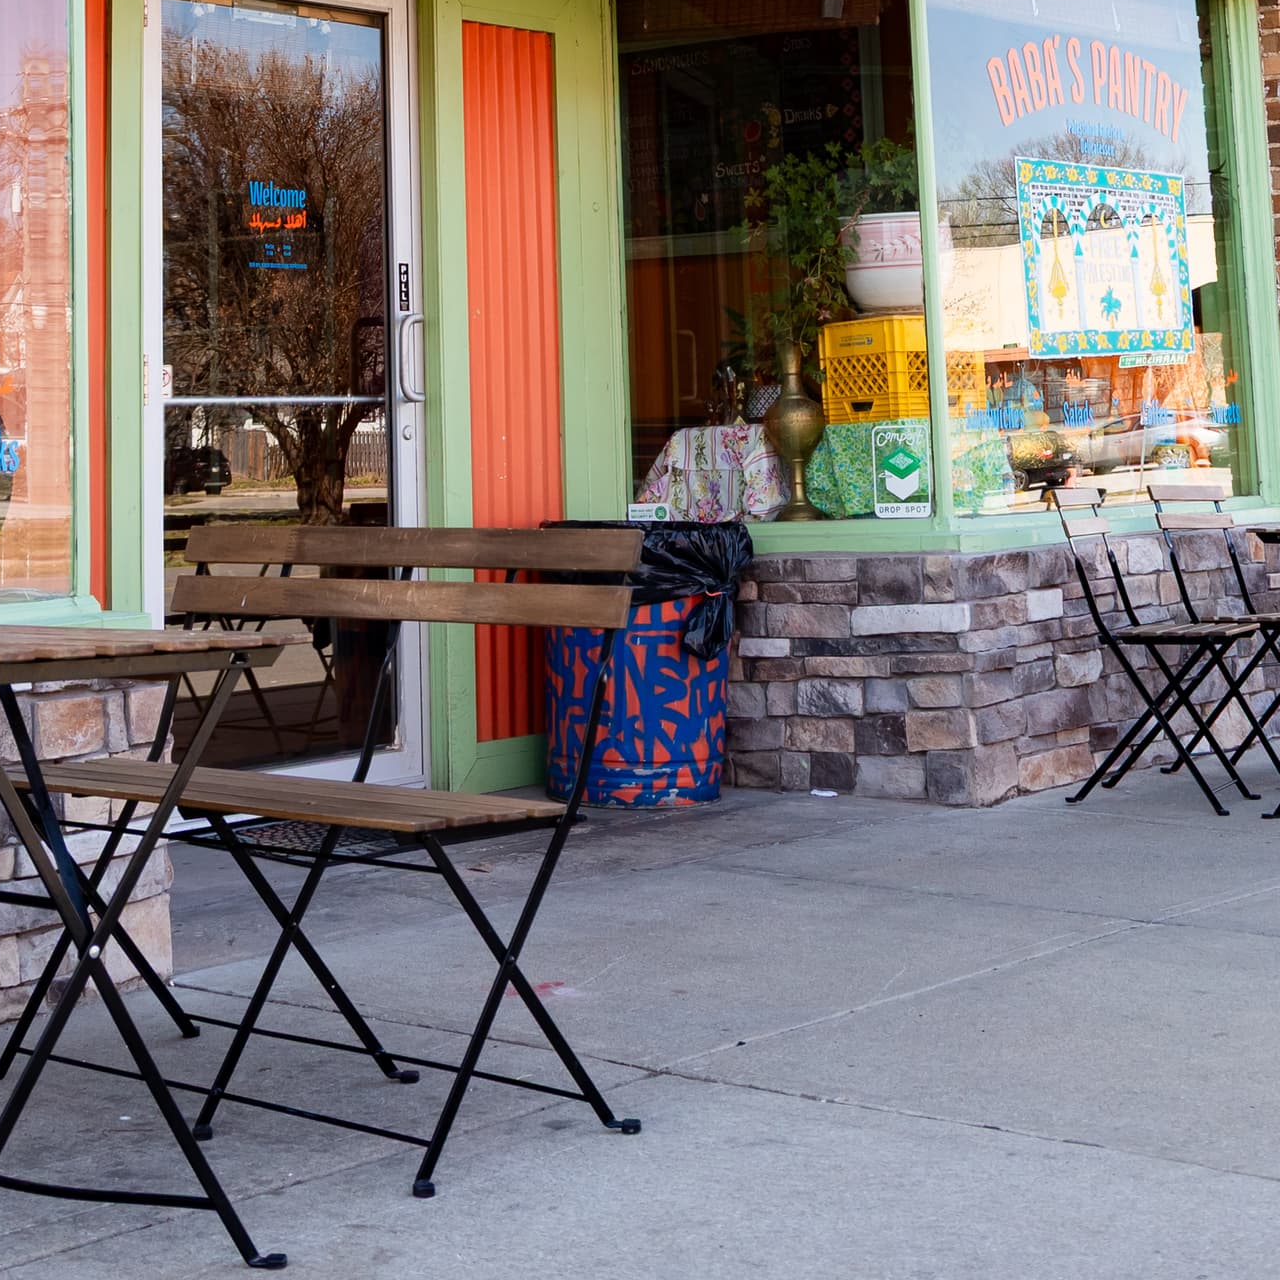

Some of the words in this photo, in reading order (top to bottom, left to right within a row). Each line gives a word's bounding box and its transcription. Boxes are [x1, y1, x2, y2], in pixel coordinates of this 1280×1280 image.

[986, 33, 1085, 127] BABA'S
[1090, 40, 1188, 144] PANTRY
[249, 180, 307, 209] Welcome
[400, 265, 408, 301] PULL
[1062, 399, 1095, 428] Salads
[879, 506, 901, 514] DROP
[905, 505, 927, 513] SPOT
